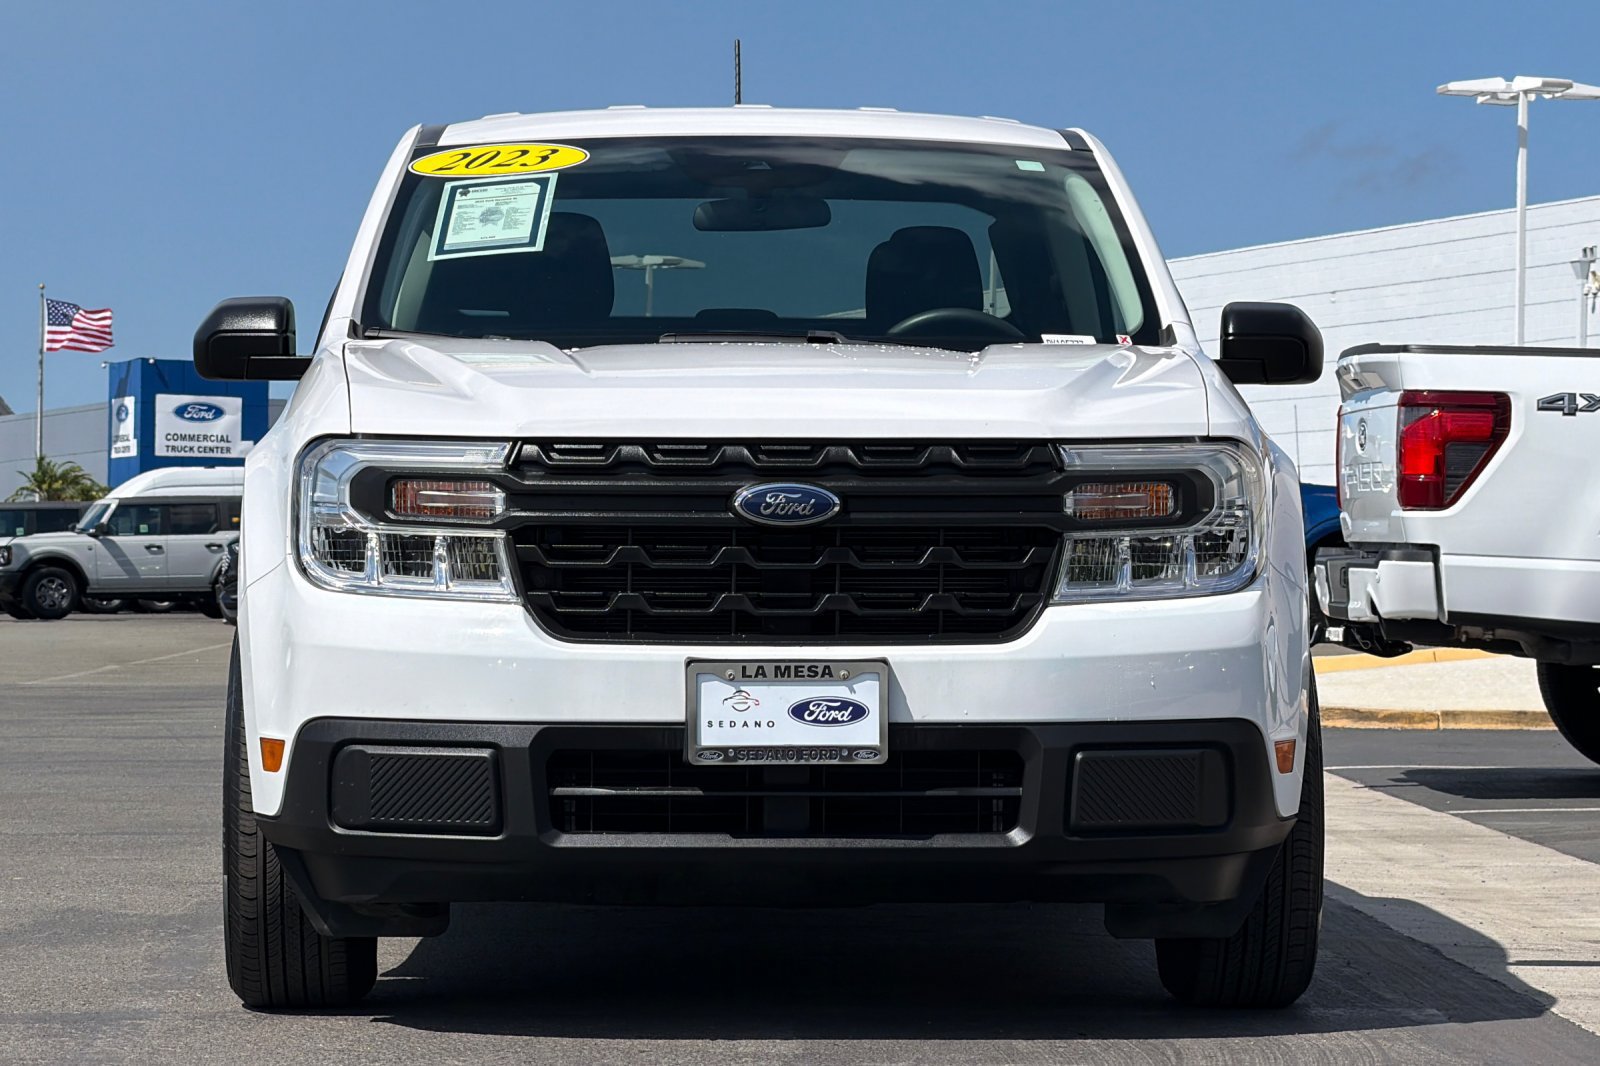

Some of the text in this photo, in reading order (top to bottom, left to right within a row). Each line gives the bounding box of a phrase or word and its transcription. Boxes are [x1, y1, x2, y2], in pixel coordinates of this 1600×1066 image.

[432, 149, 560, 172] 2023
[183, 404, 216, 420] Ford
[165, 433, 232, 443] COMMERCIAL
[165, 445, 232, 454] TRUCK CENTER
[760, 492, 816, 515] Ford
[741, 665, 834, 678] LA MESA
[804, 701, 853, 722] Ford
[707, 720, 775, 728] SEDANO
[737, 749, 839, 762] SEDANO FORD
